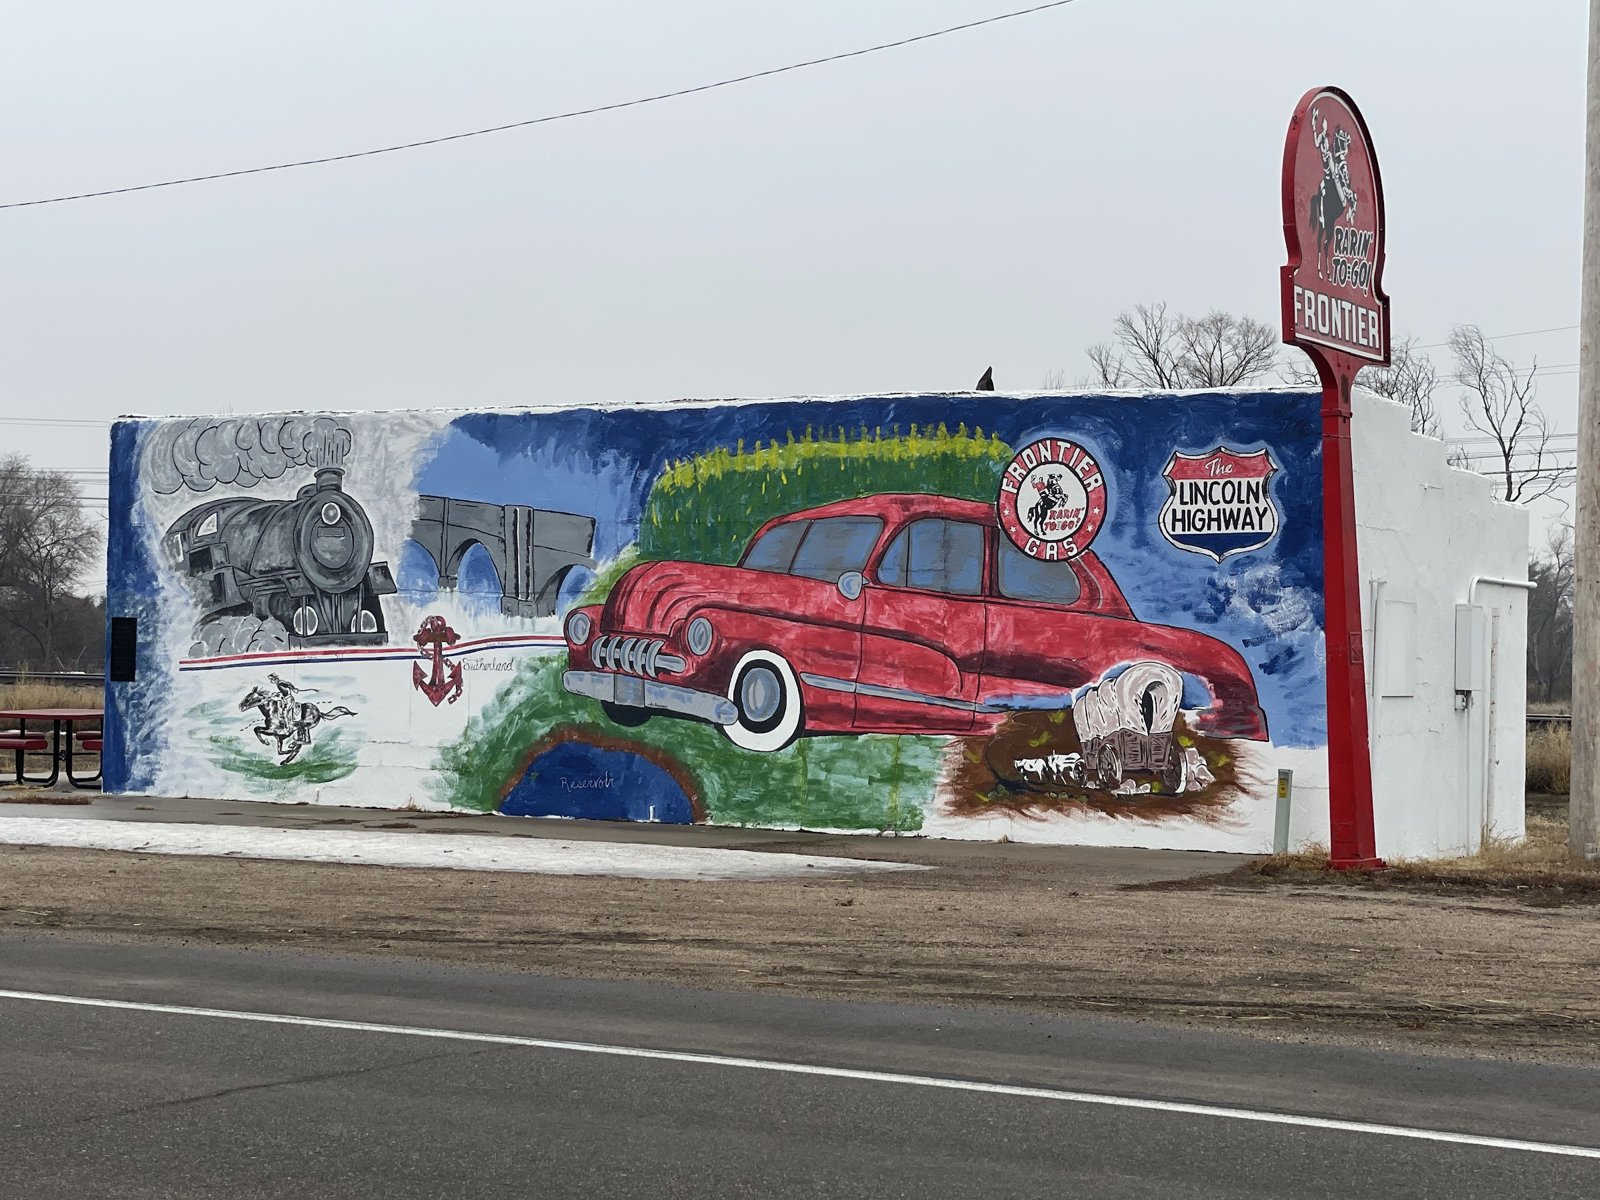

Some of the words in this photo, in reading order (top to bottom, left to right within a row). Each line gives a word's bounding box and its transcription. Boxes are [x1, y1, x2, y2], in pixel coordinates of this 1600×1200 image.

[1294, 285, 1380, 349] FRONTIER
[1001, 440, 1103, 494] FRONTIER
[1204, 458, 1234, 477] The
[1179, 480, 1260, 506] LINCOLN
[1171, 506, 1268, 532] HIGHWAY
[1024, 537, 1078, 560] GAS
